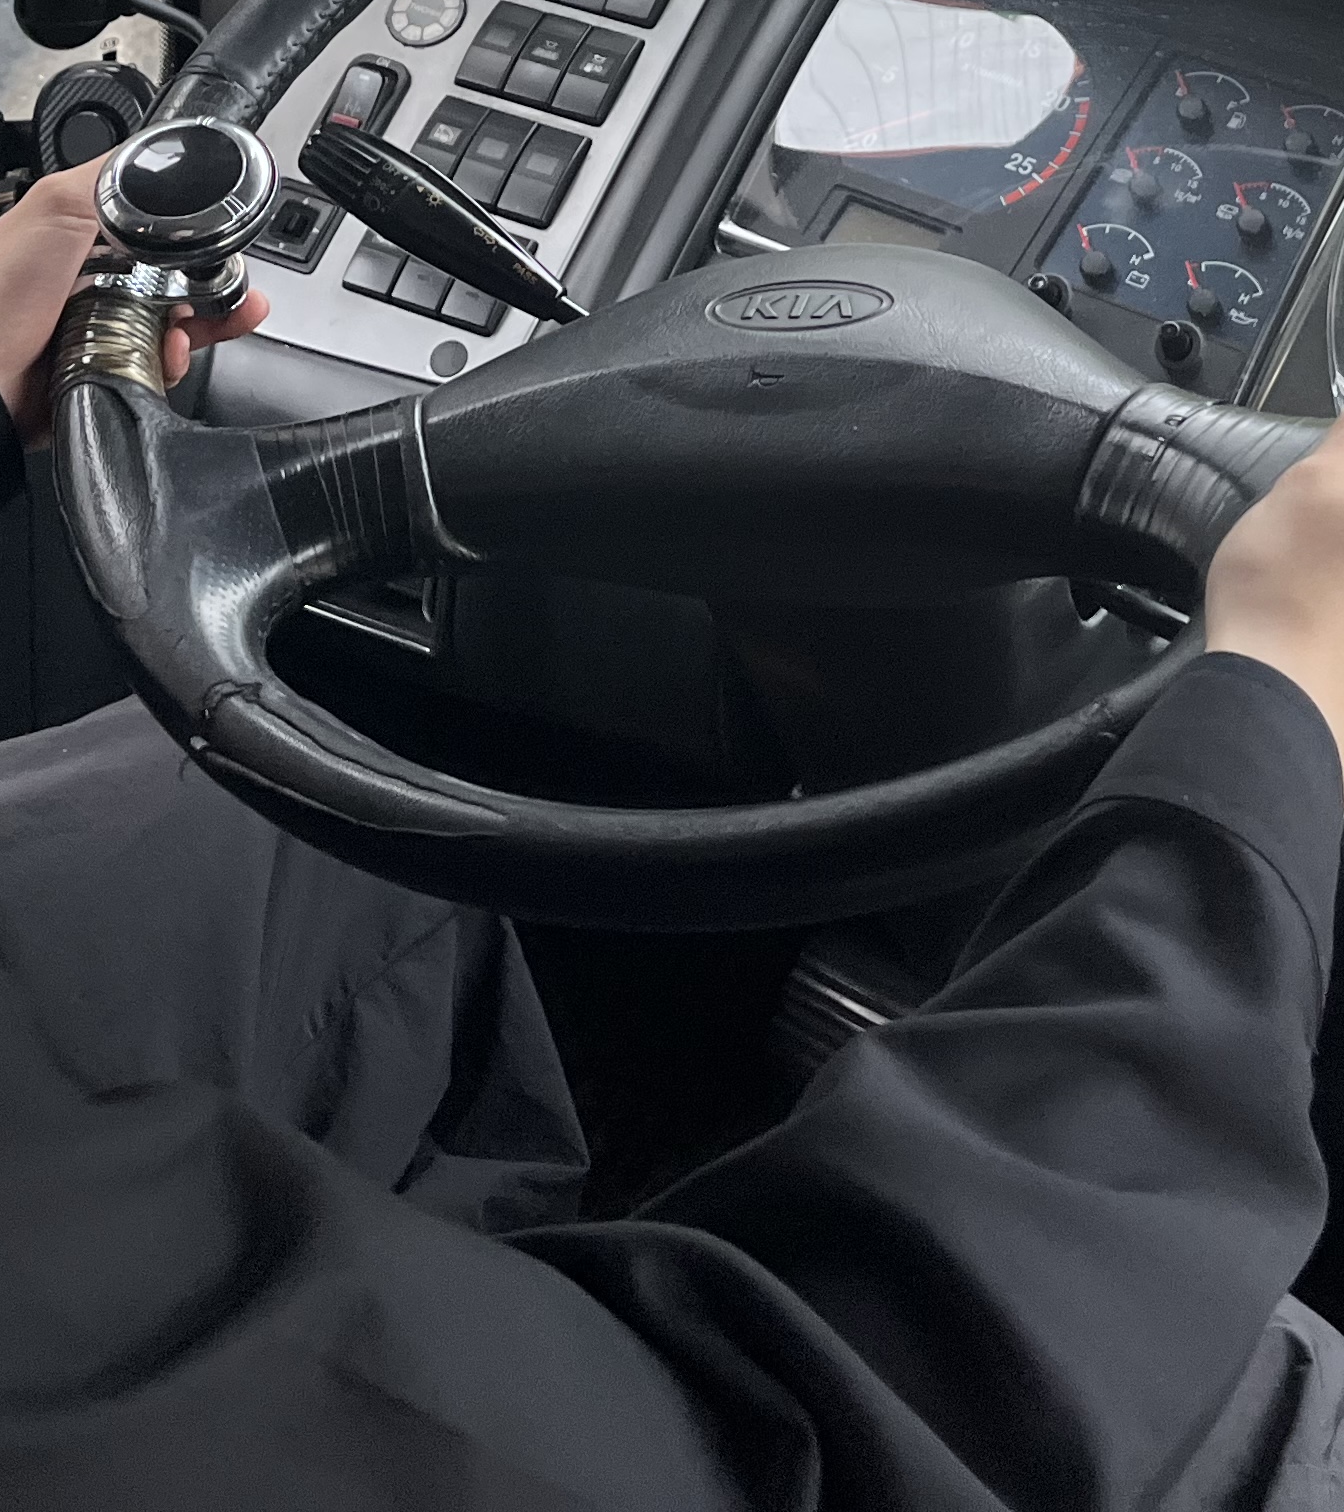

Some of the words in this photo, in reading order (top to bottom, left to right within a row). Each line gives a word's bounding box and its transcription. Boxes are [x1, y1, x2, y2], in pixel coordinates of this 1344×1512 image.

[1041, 90, 1071, 112] 20
[1004, 153, 1037, 176] 25
[740, 292, 854, 320] KIA
